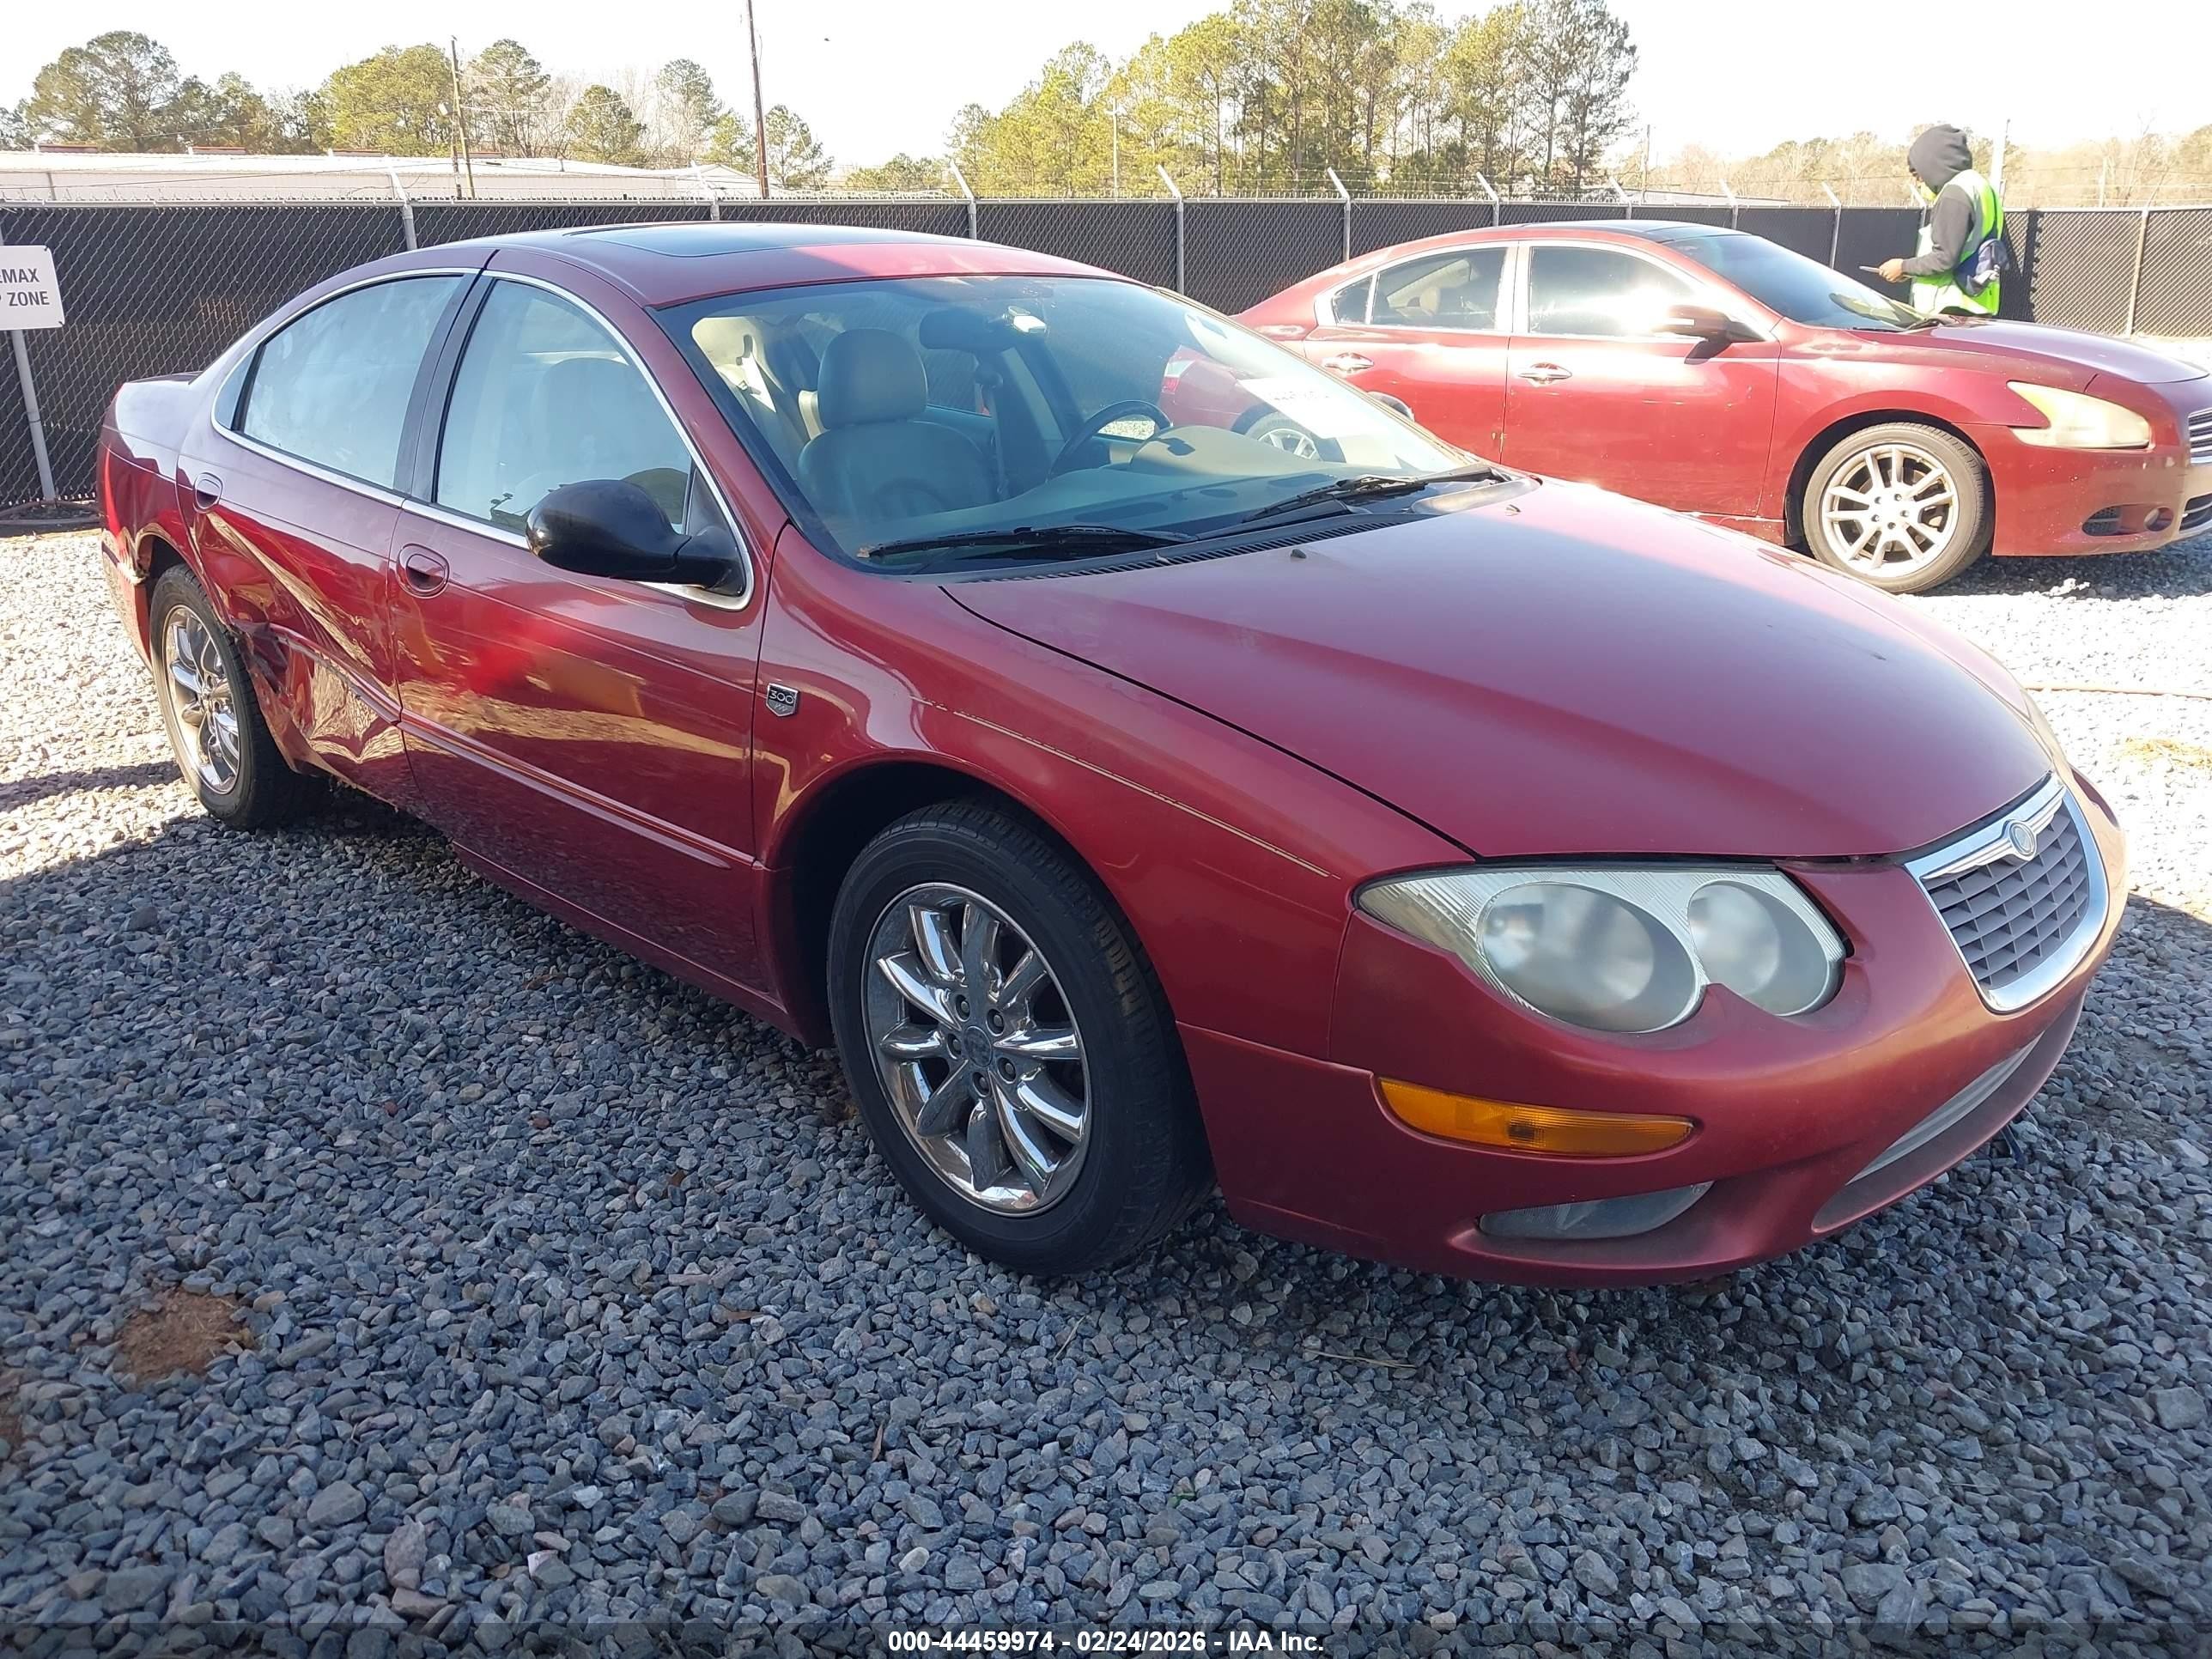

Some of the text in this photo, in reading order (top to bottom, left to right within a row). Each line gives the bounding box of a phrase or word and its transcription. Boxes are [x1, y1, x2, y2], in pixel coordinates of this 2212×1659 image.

[0, 268, 40, 283] MAX
[7, 291, 50, 307] ZONE
[769, 690, 794, 704] 300
